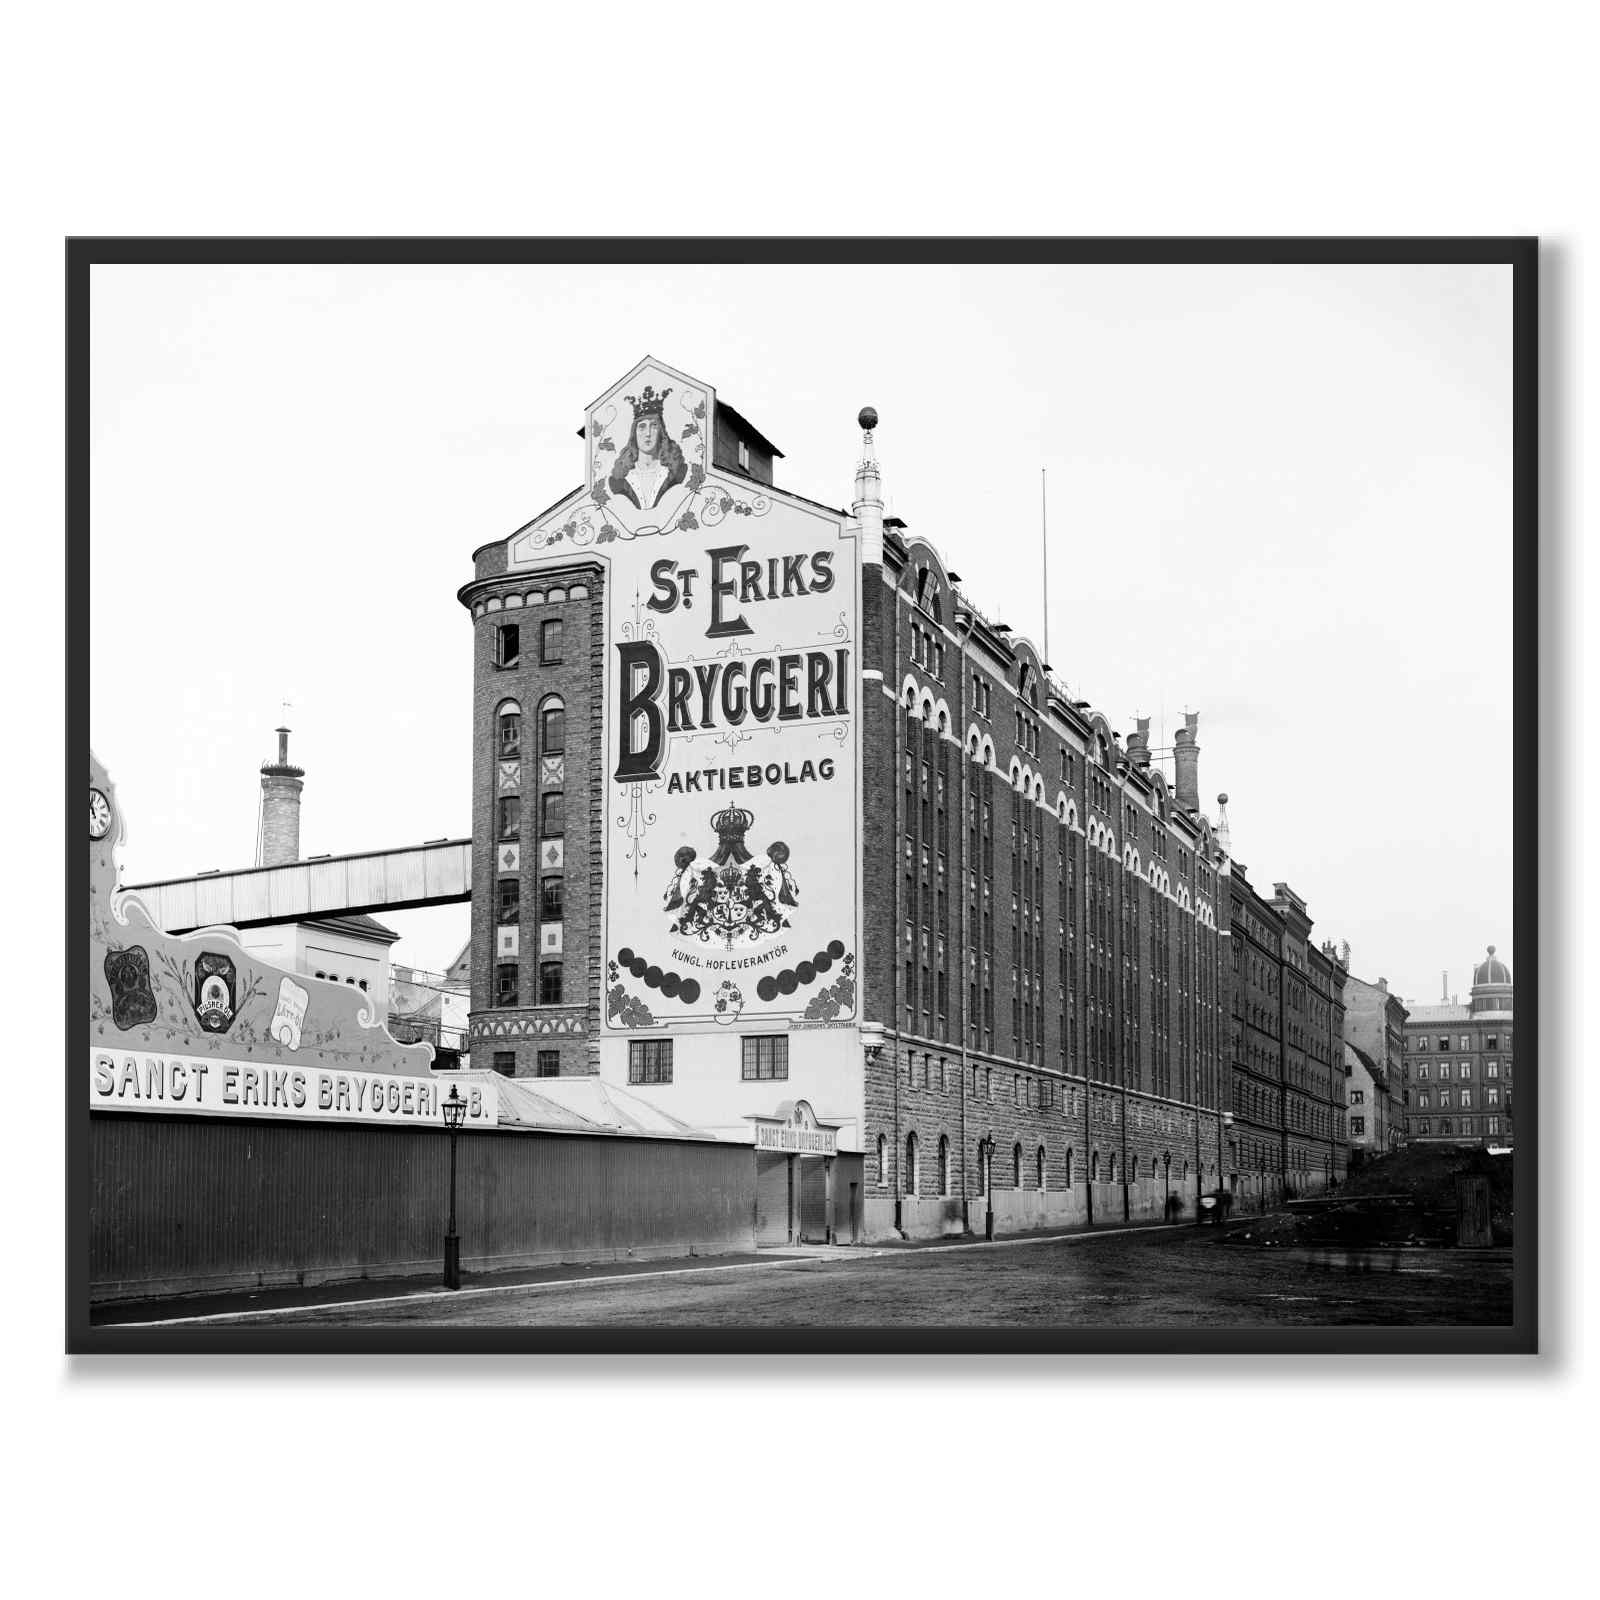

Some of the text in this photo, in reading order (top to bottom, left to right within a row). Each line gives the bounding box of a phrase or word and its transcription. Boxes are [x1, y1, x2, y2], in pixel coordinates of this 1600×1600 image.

[704, 544, 835, 638] ERIKS
[613, 640, 850, 783] BRYGGERI
[667, 757, 835, 794] AKTIEBOLAG
[672, 944, 789, 970] KUNGL. HOFLEVERANTÖR
[95, 1054, 209, 1102] SANCT
[222, 1065, 306, 1108] ERIKS
[318, 1075, 438, 1117] BRYGGERI
